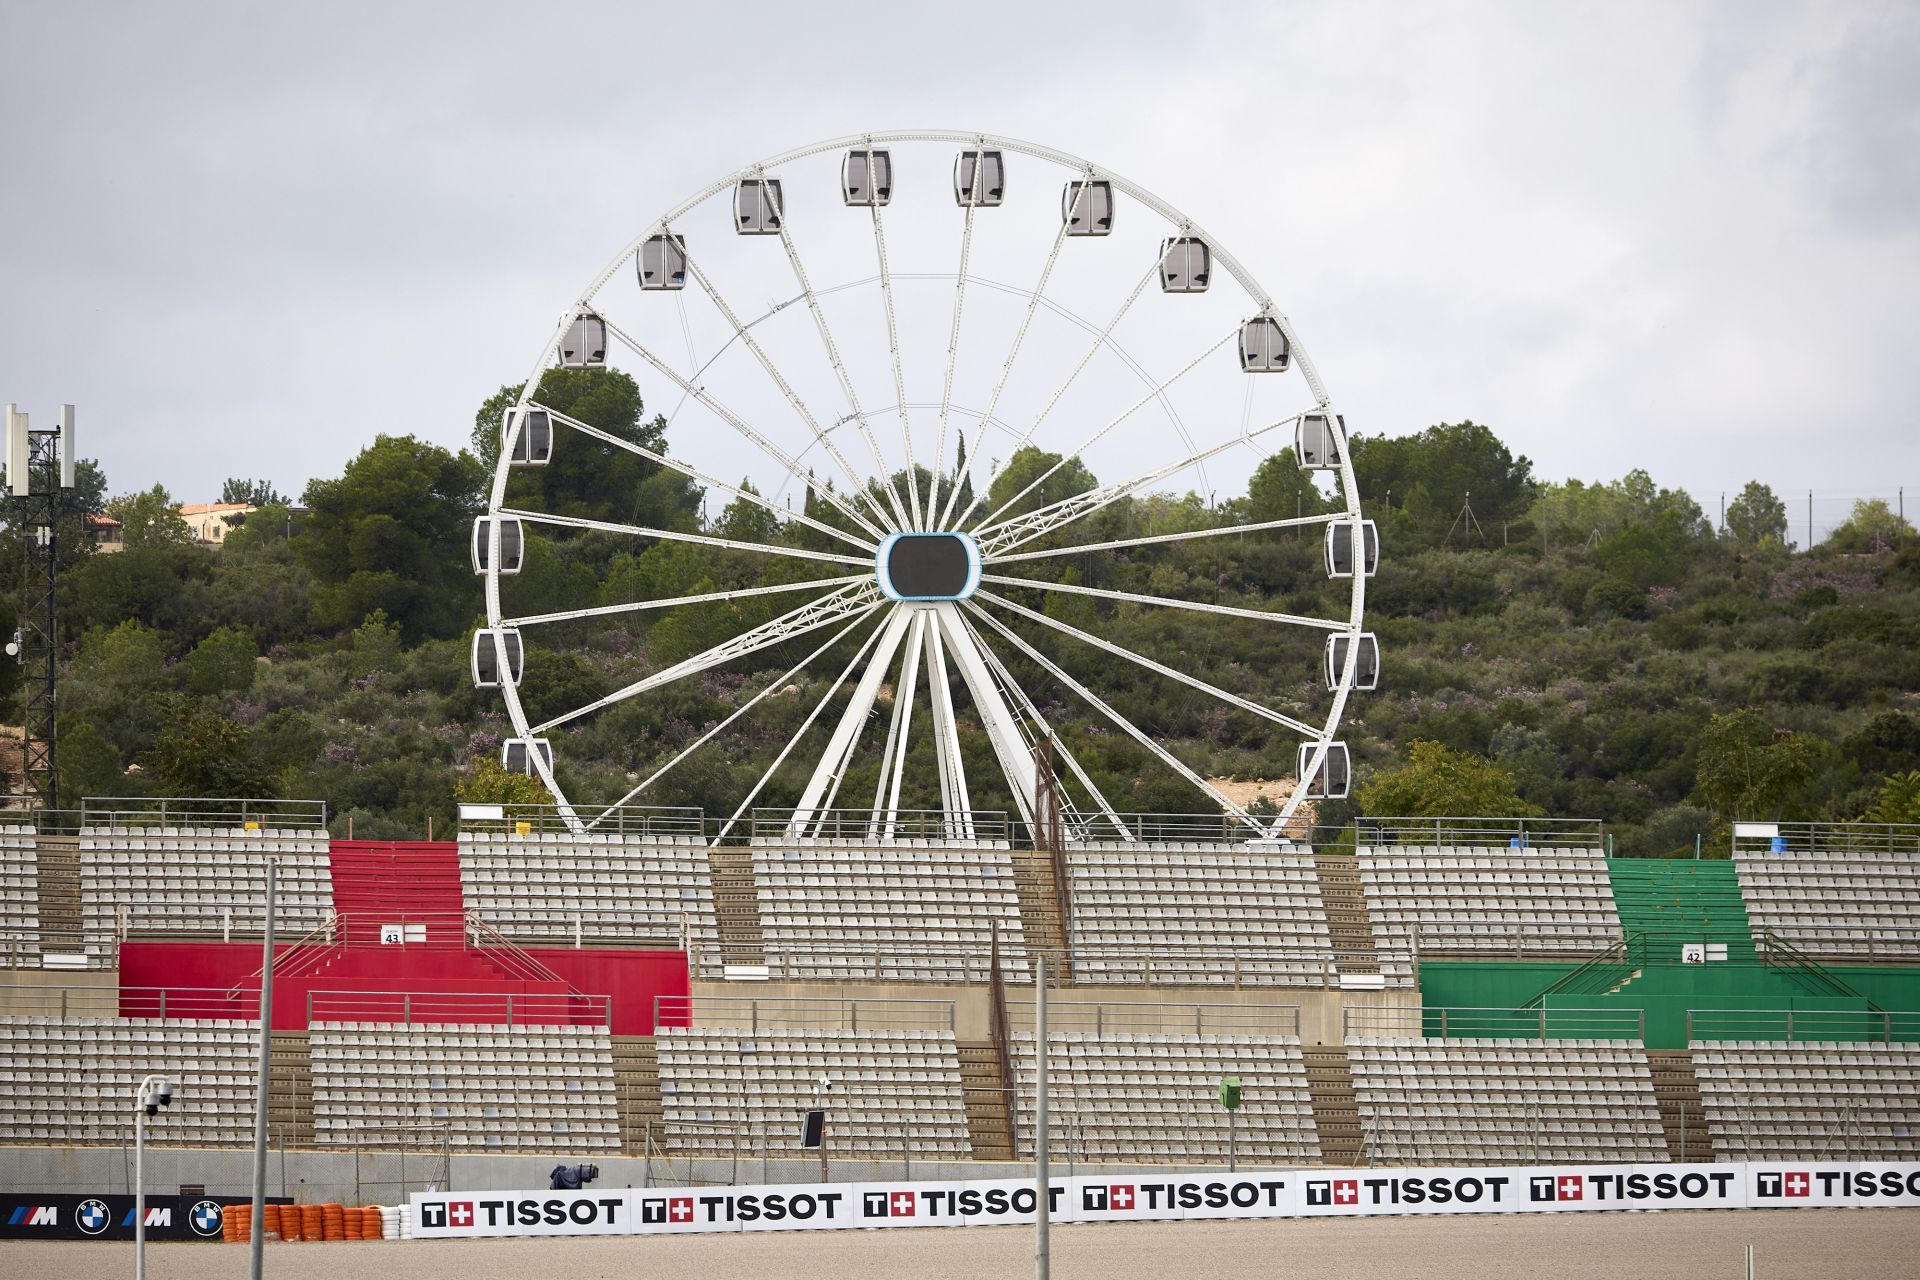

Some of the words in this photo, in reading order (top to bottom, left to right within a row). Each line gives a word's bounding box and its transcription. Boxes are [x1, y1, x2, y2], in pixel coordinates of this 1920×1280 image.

[386, 934, 399, 943] 43
[1687, 953, 1700, 962] 42
[1140, 1182, 1285, 1210] TISSOT
[1364, 1177, 1509, 1205] TISSOT
[1588, 1173, 1735, 1200] TISSOT
[1815, 1171, 1920, 1198] TISSO
[80, 1201, 106, 1211] BMW
[194, 1202, 220, 1213] BMW
[480, 1199, 622, 1226] TISSOT
[700, 1193, 842, 1222] TISSOT
[921, 1187, 1065, 1217] TISSOT
